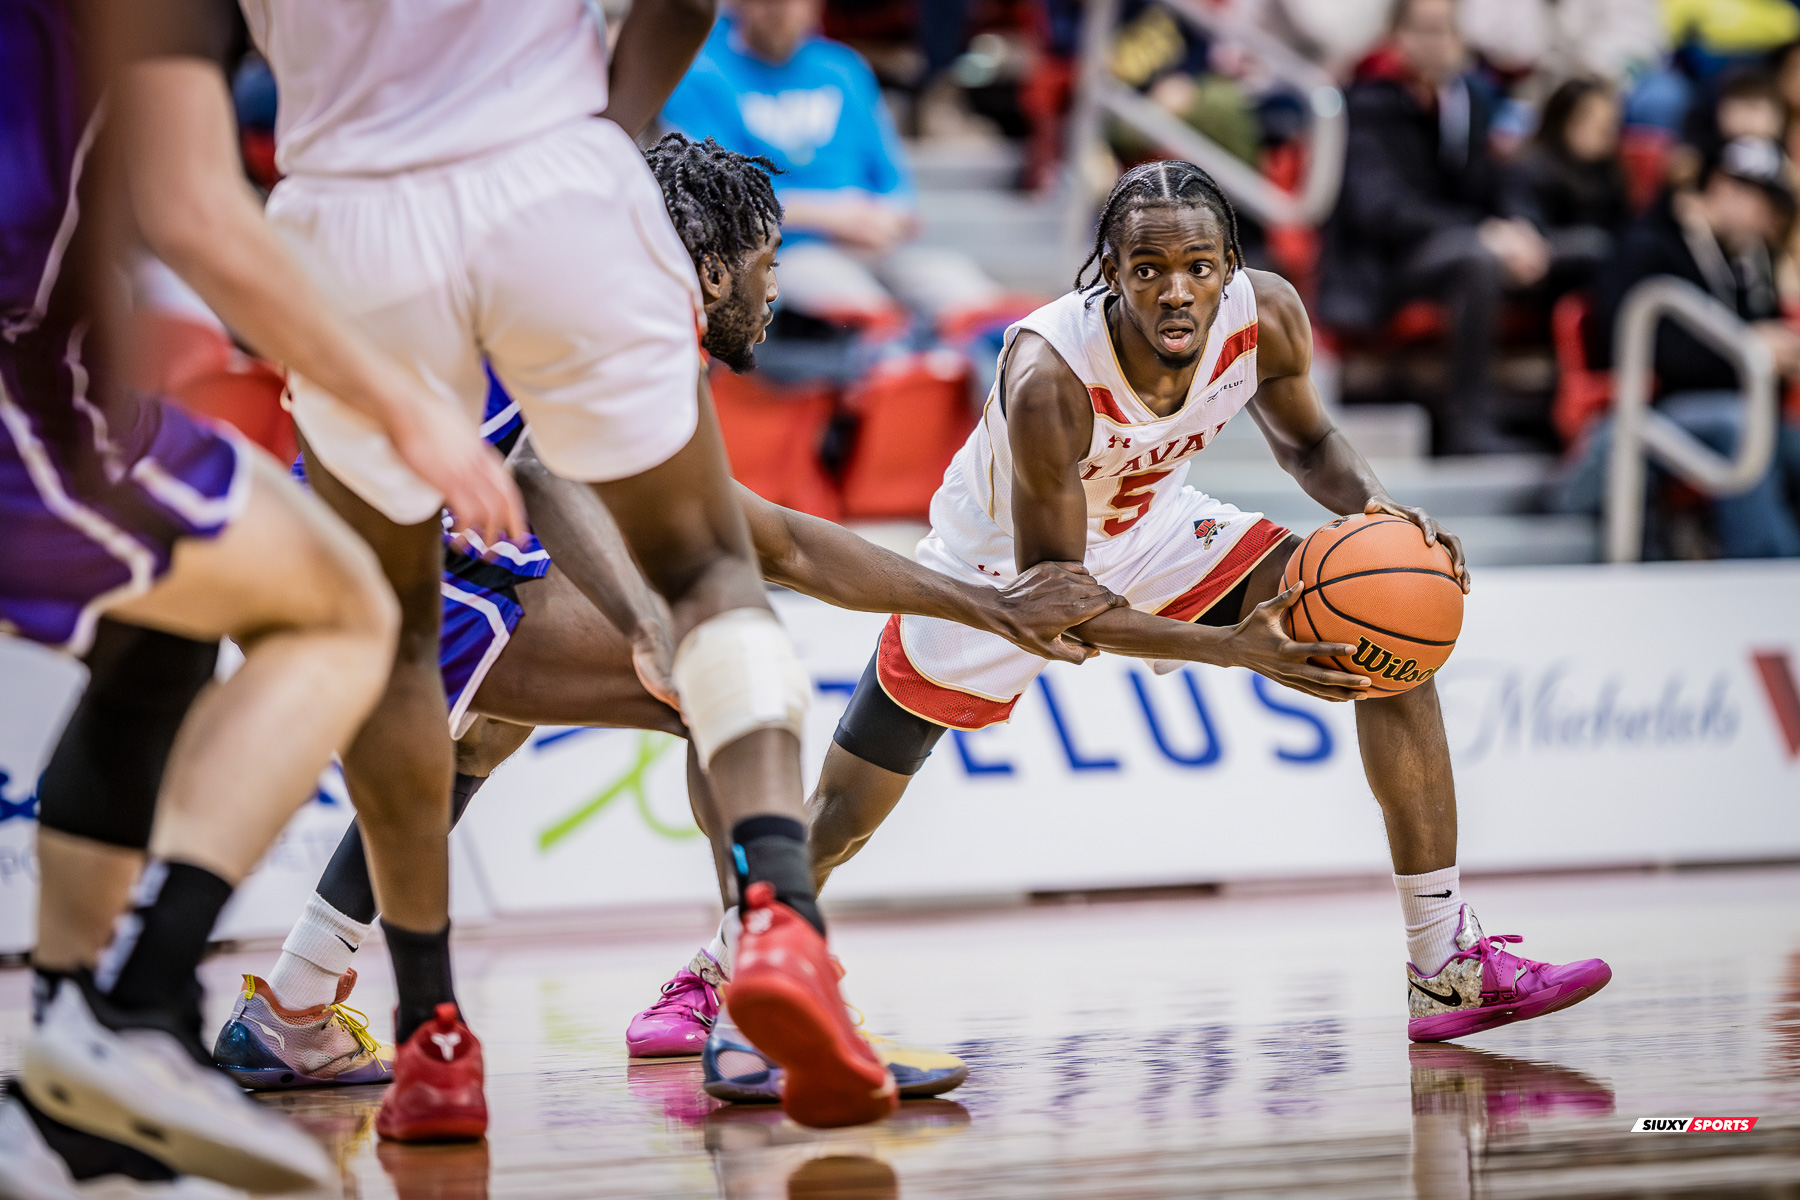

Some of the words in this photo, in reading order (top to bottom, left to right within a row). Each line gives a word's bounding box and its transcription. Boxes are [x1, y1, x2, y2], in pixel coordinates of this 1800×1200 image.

[1101, 469, 1173, 538] 5
[1193, 518, 1217, 538] UL
[1350, 635, 1442, 684] Wilso
